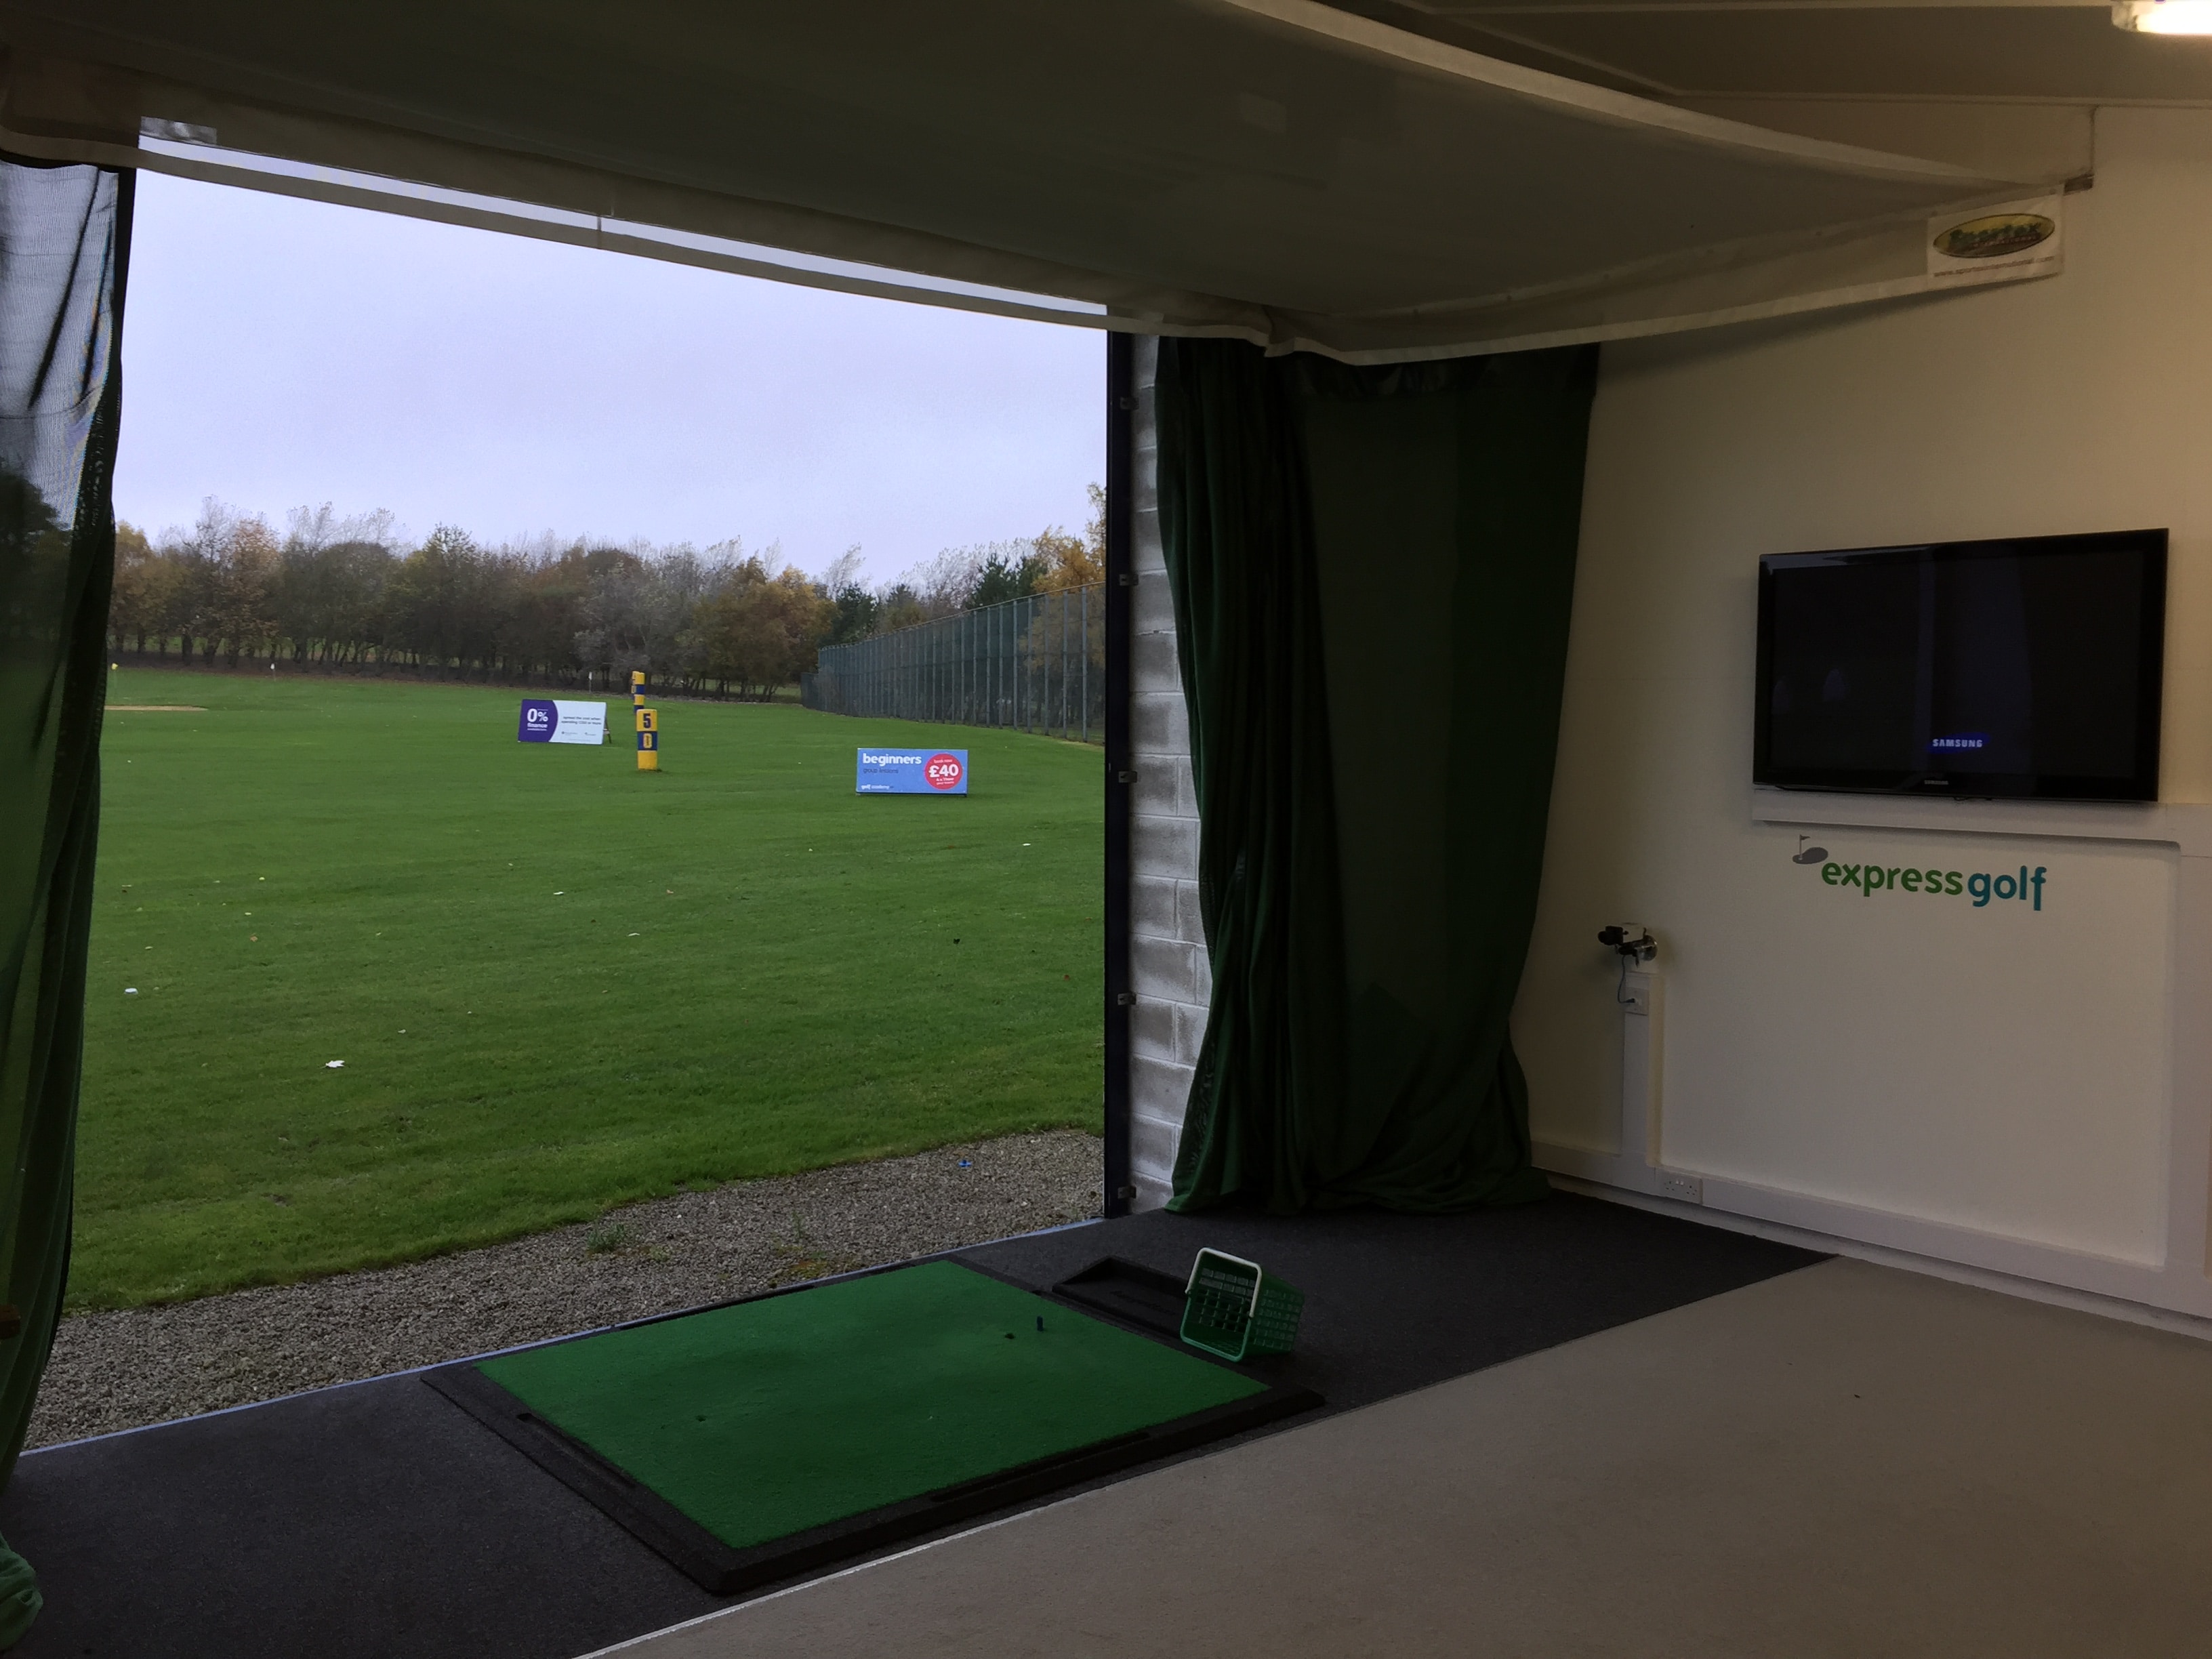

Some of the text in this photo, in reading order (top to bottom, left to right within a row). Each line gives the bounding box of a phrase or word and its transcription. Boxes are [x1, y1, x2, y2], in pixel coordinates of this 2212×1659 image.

[527, 708, 549, 722] 0%
[1932, 739, 1983, 747] SAMSUNG
[862, 752, 922, 766] beginners
[928, 763, 959, 777] £40
